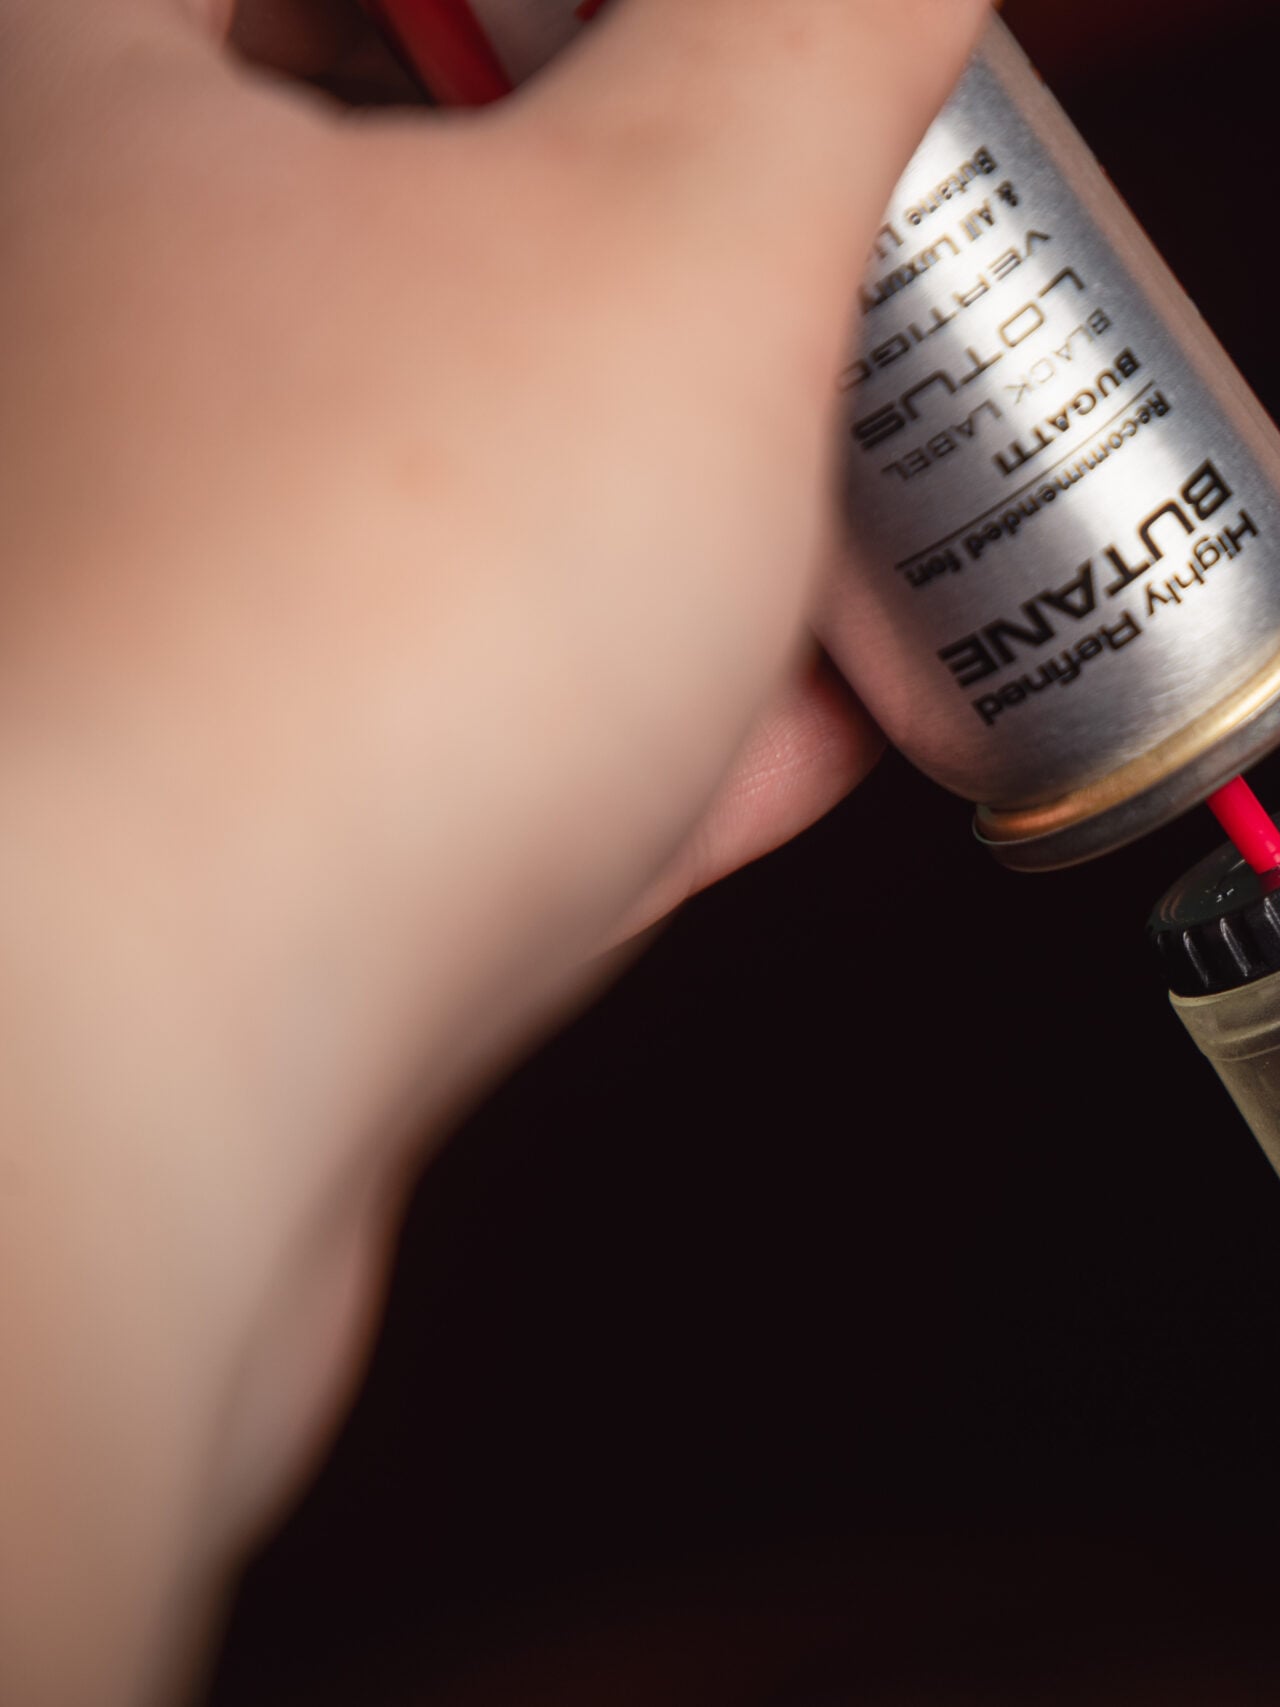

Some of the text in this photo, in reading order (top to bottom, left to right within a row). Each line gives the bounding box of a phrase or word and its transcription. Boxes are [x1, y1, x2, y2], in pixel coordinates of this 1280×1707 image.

[904, 145, 998, 225] Butane
[959, 198, 995, 241] All
[852, 266, 1085, 450] LOTUS
[880, 307, 1112, 481] BLACK LABEL
[992, 346, 1141, 477] BUGATTI
[962, 390, 1171, 560] Recommended
[936, 457, 1234, 689] BUTANE
[971, 508, 1259, 727] Highly Refined
